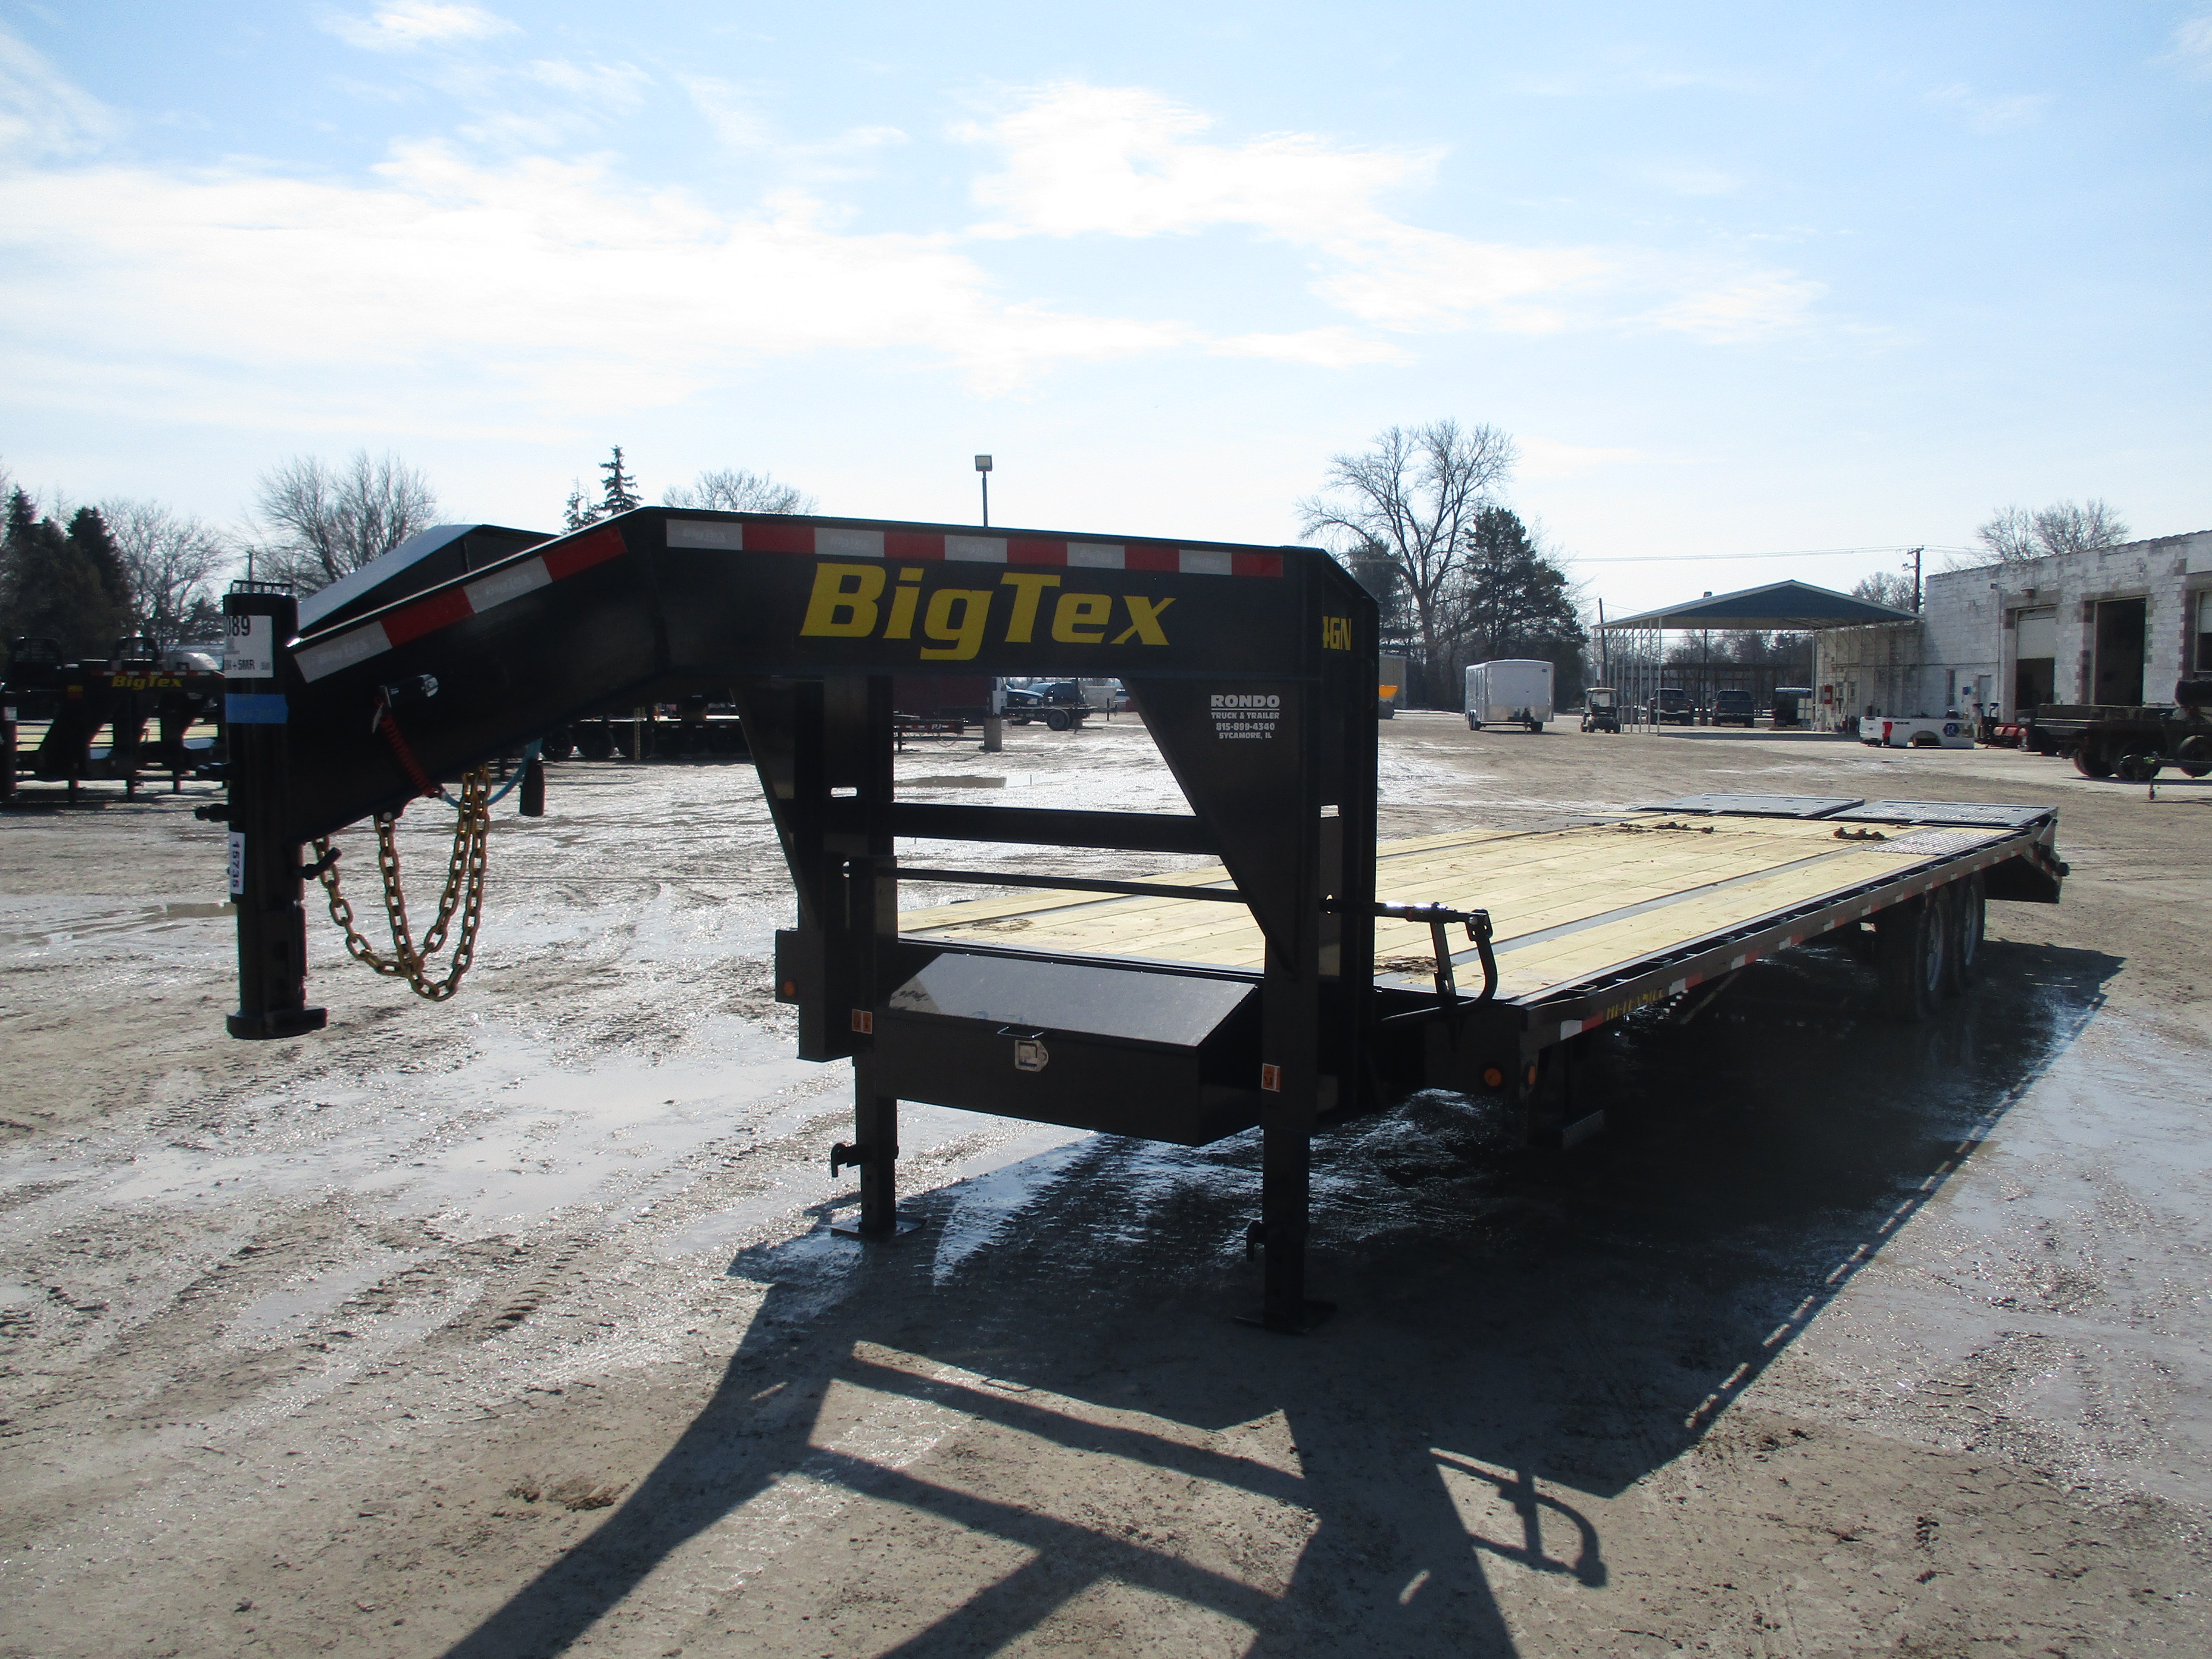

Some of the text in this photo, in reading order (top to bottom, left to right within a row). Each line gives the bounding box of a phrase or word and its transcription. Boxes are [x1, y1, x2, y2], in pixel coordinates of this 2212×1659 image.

[799, 563, 1177, 661] BigTex
[111, 675, 183, 690] BigTex
[1211, 694, 1280, 708] RONDO
[1216, 722, 1275, 731] 815-899-4340
